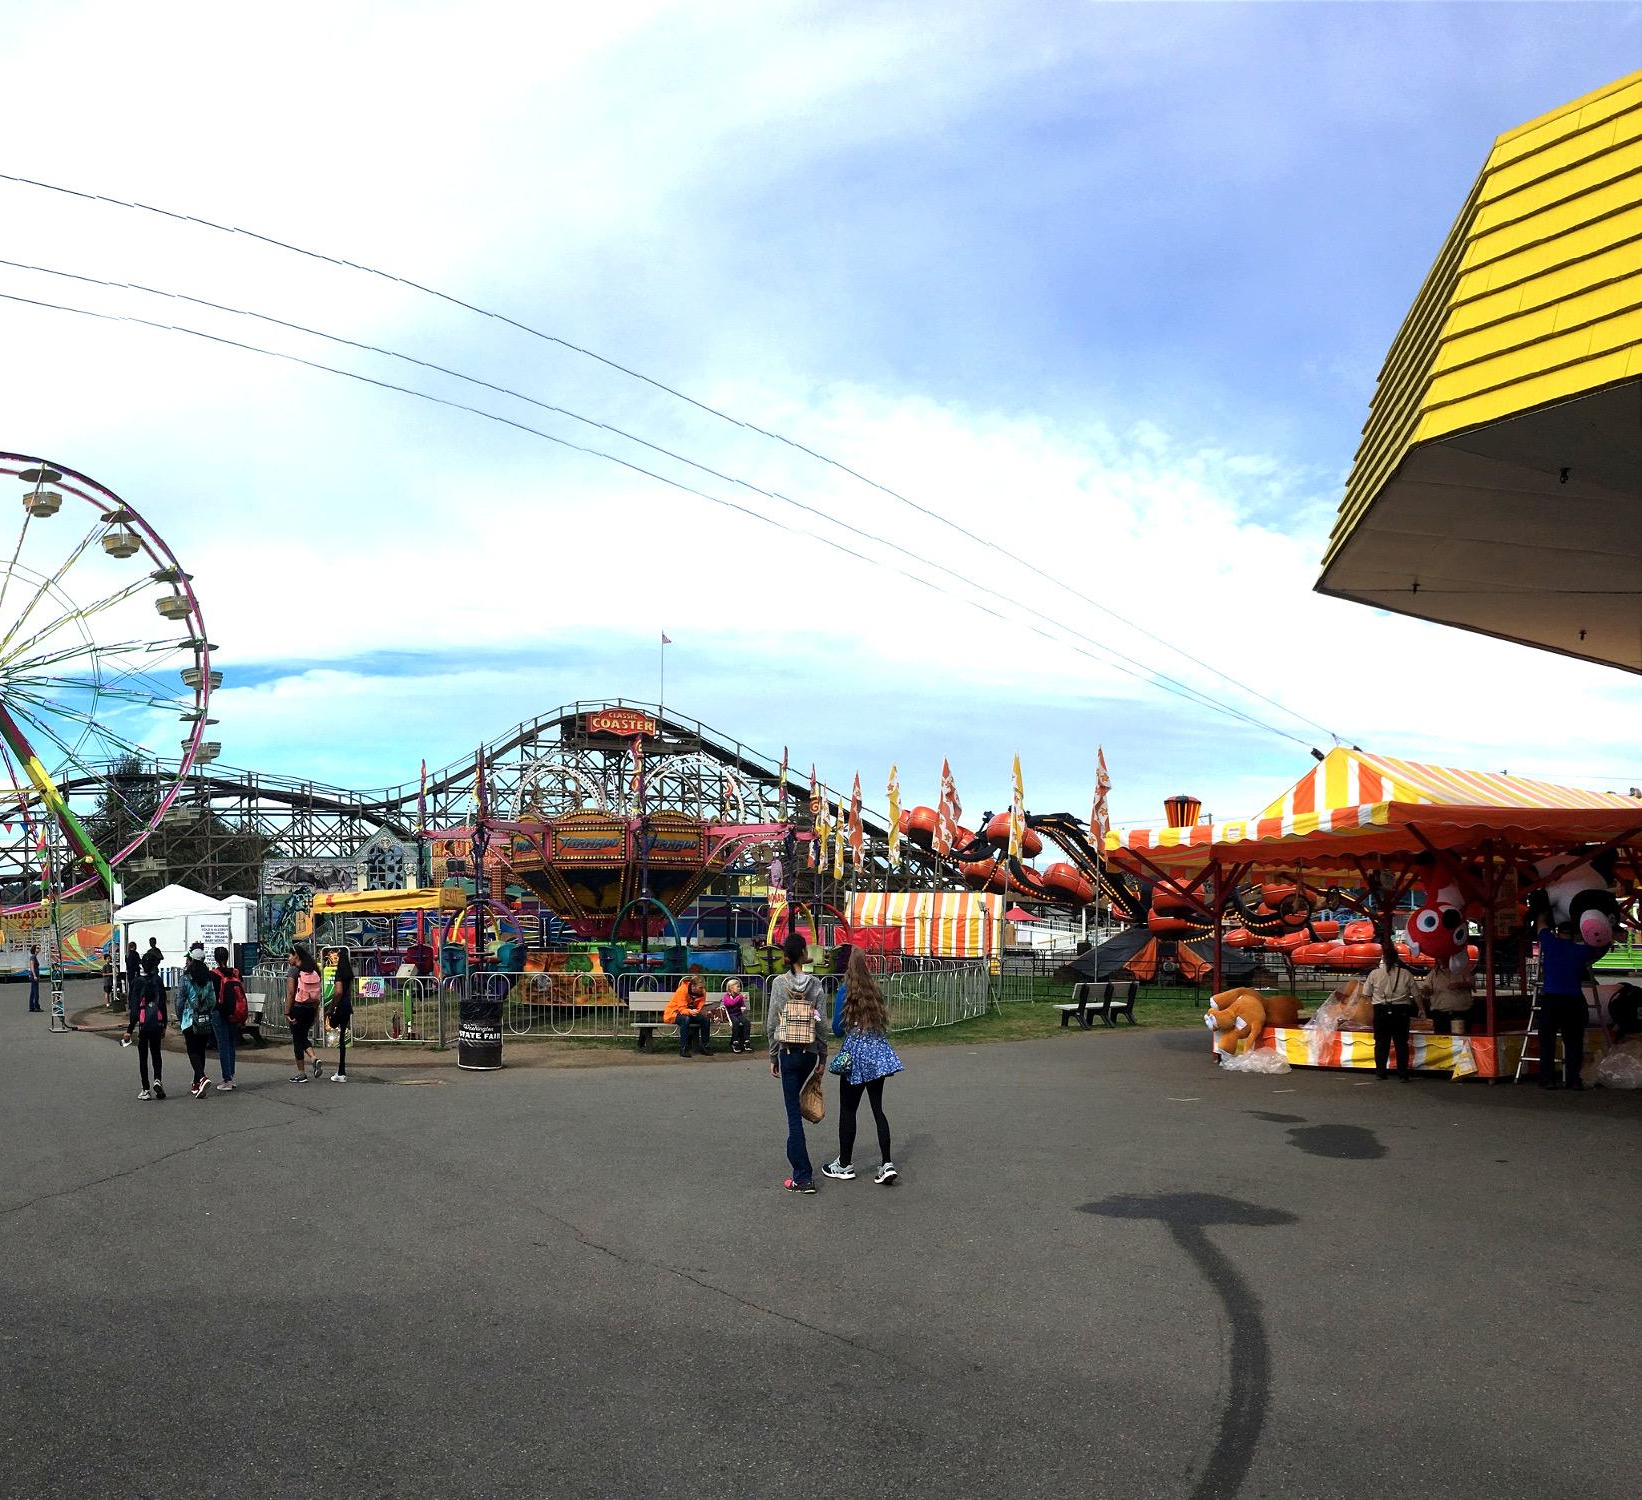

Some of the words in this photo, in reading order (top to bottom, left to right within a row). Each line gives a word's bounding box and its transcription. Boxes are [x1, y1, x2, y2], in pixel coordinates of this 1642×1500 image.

[608, 712, 638, 720] CLASSIC
[592, 718, 653, 732] COASTER
[559, 836, 621, 850] TORNADO
[444, 888, 458, 903] EXIT
[364, 981, 380, 993] 10
[459, 1030, 482, 1040] STATE
